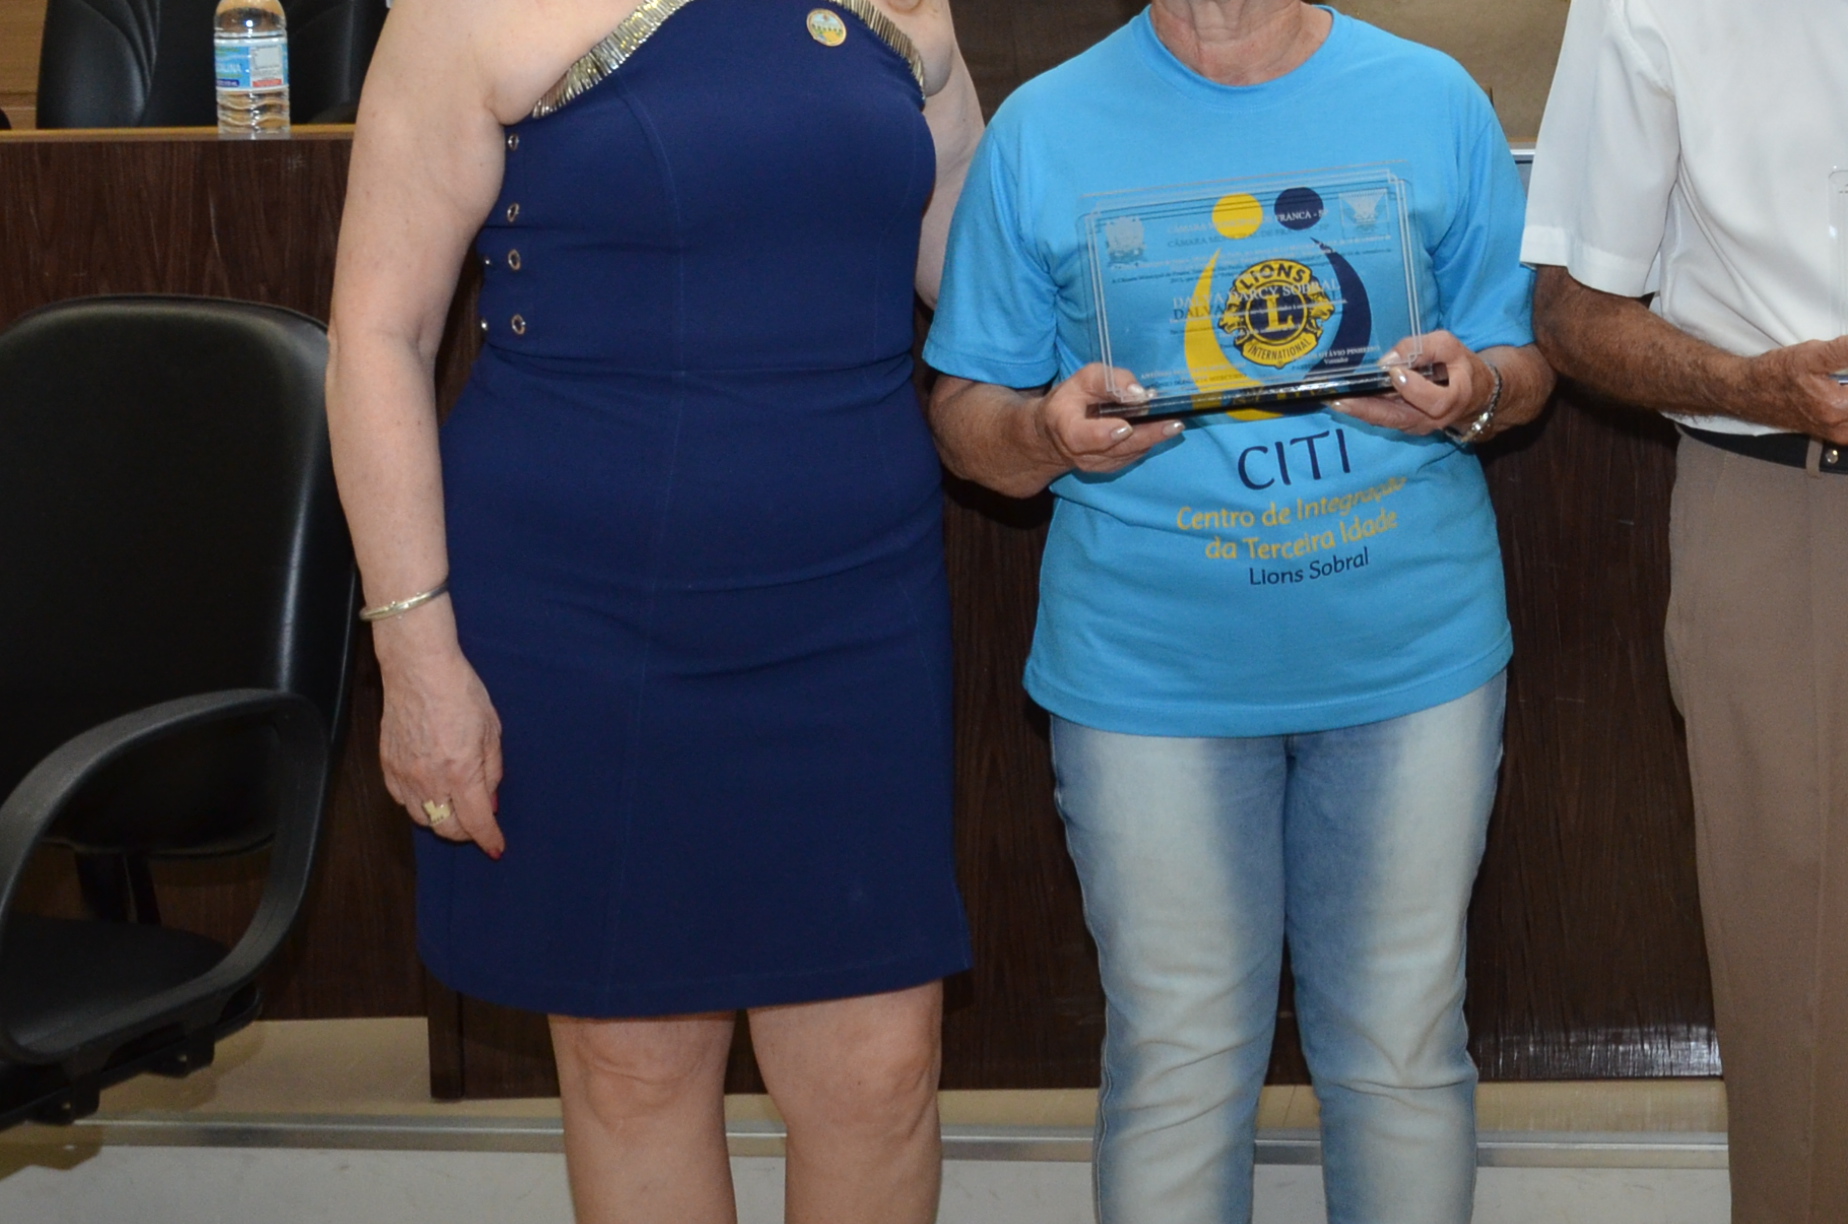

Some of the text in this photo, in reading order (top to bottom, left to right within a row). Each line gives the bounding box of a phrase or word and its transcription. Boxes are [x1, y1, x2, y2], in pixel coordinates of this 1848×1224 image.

[1239, 263, 1307, 289] LIONS
[1265, 293, 1294, 331] L
[1248, 338, 1312, 361] INTERNATIONAL
[1238, 428, 1351, 490] CITI
[1176, 476, 1408, 530] Centro de Integração
[1205, 507, 1399, 560] da Terceira Idade
[1249, 546, 1370, 585] Lions Sobral
